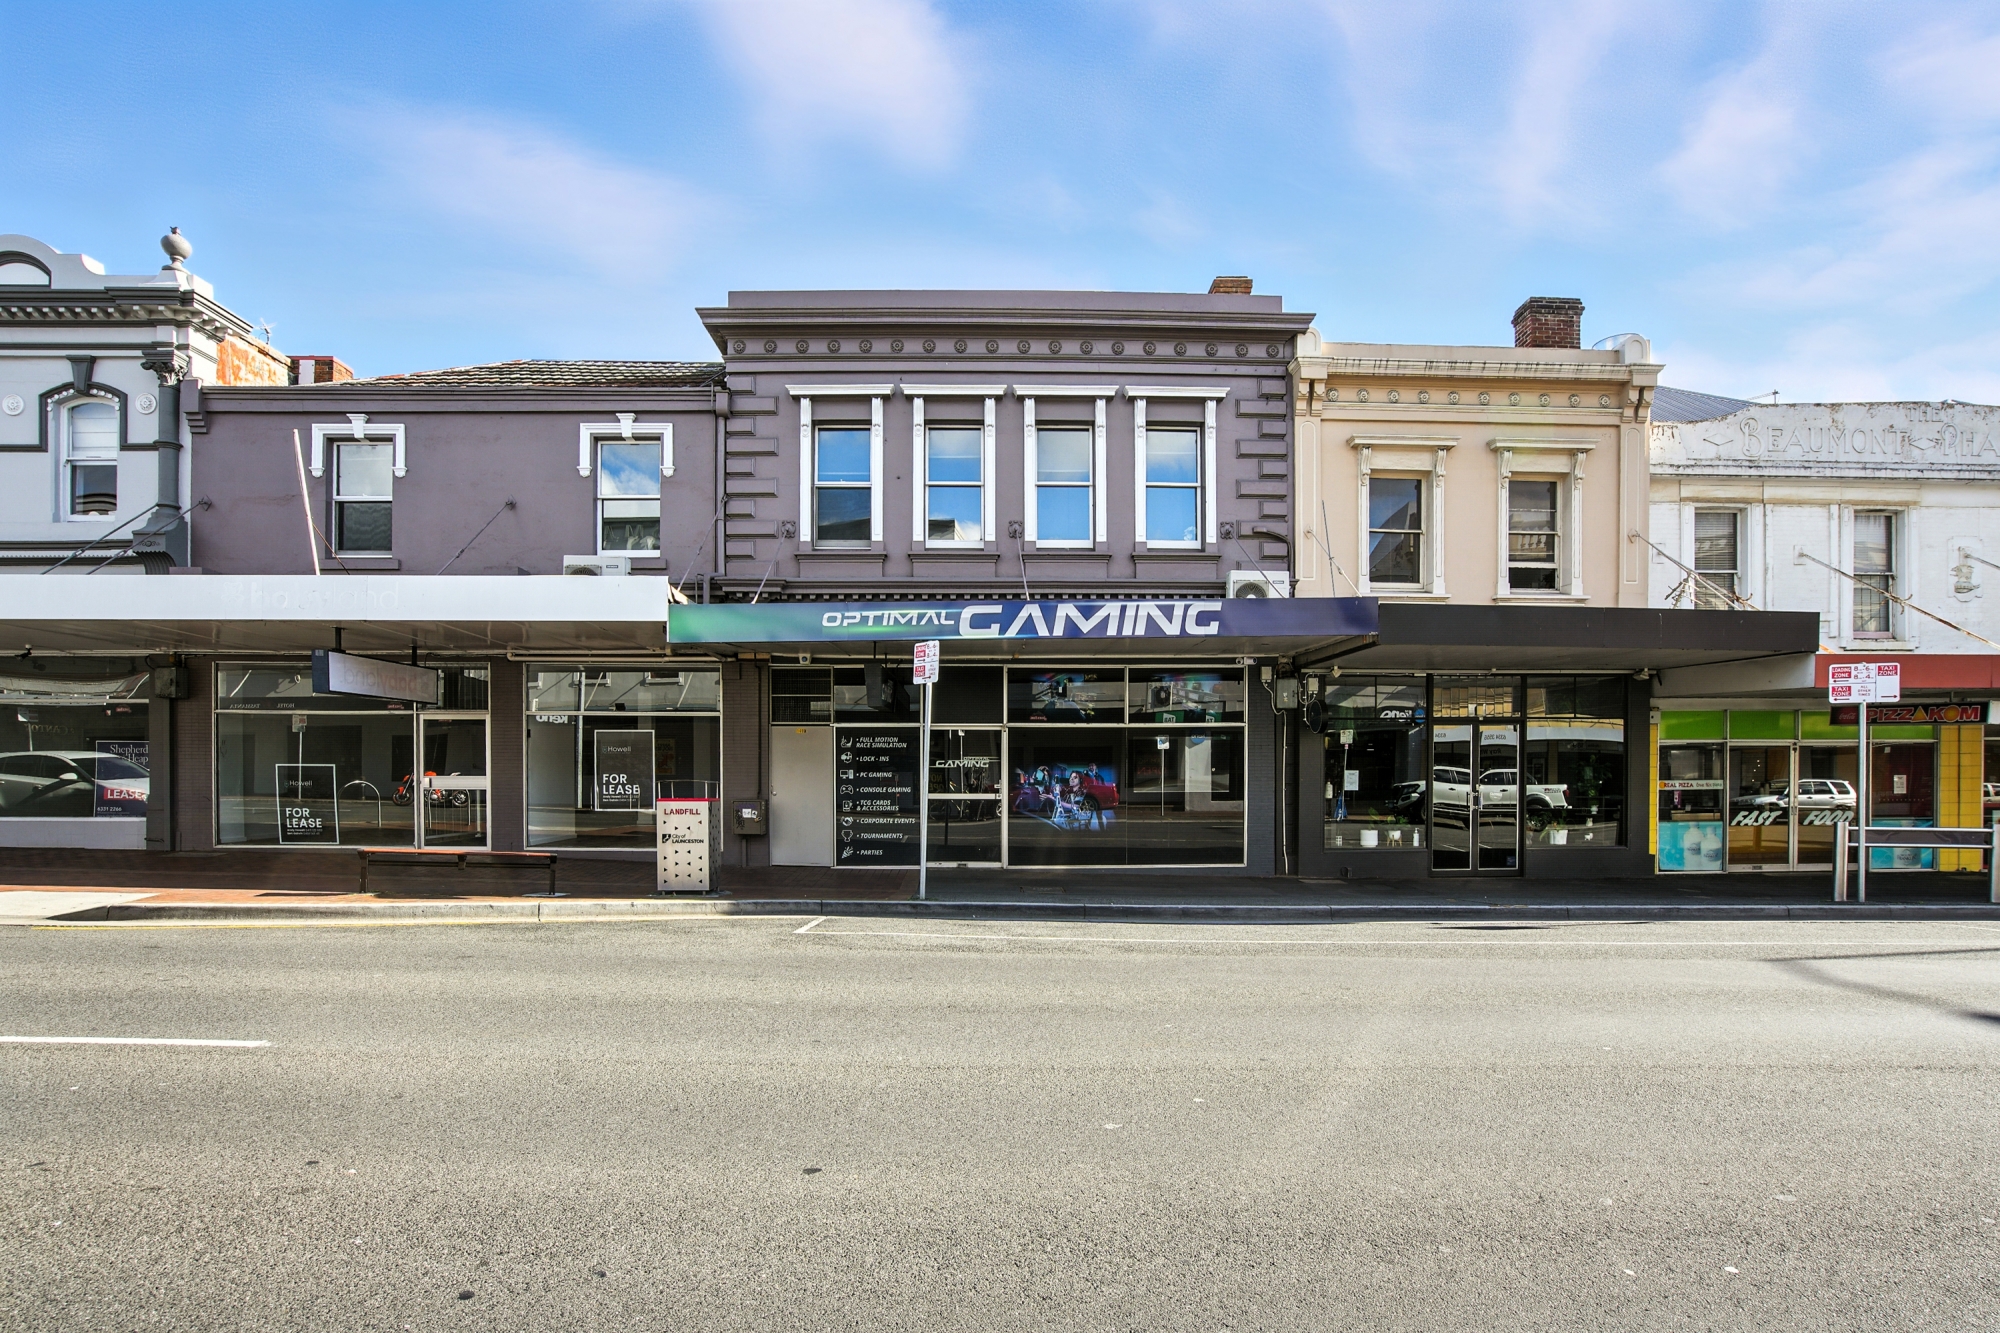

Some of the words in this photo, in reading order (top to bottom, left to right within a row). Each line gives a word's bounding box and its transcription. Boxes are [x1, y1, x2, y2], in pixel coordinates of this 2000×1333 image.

[1908, 407, 1944, 423] THE
[1740, 416, 1907, 458] BEAUMONT
[822, 610, 954, 627] OPTIMAL
[959, 602, 1222, 637] GAMING
[109, 744, 149, 758] Shepherd
[935, 760, 989, 768] GAMING
[602, 774, 627, 784] FOR
[107, 789, 142, 799] LEASE
[602, 784, 640, 794] LEASE
[286, 808, 310, 817] FOR
[1730, 810, 1783, 826] FAST
[1803, 810, 1855, 826] FOOD
[286, 819, 322, 828] LEASE
